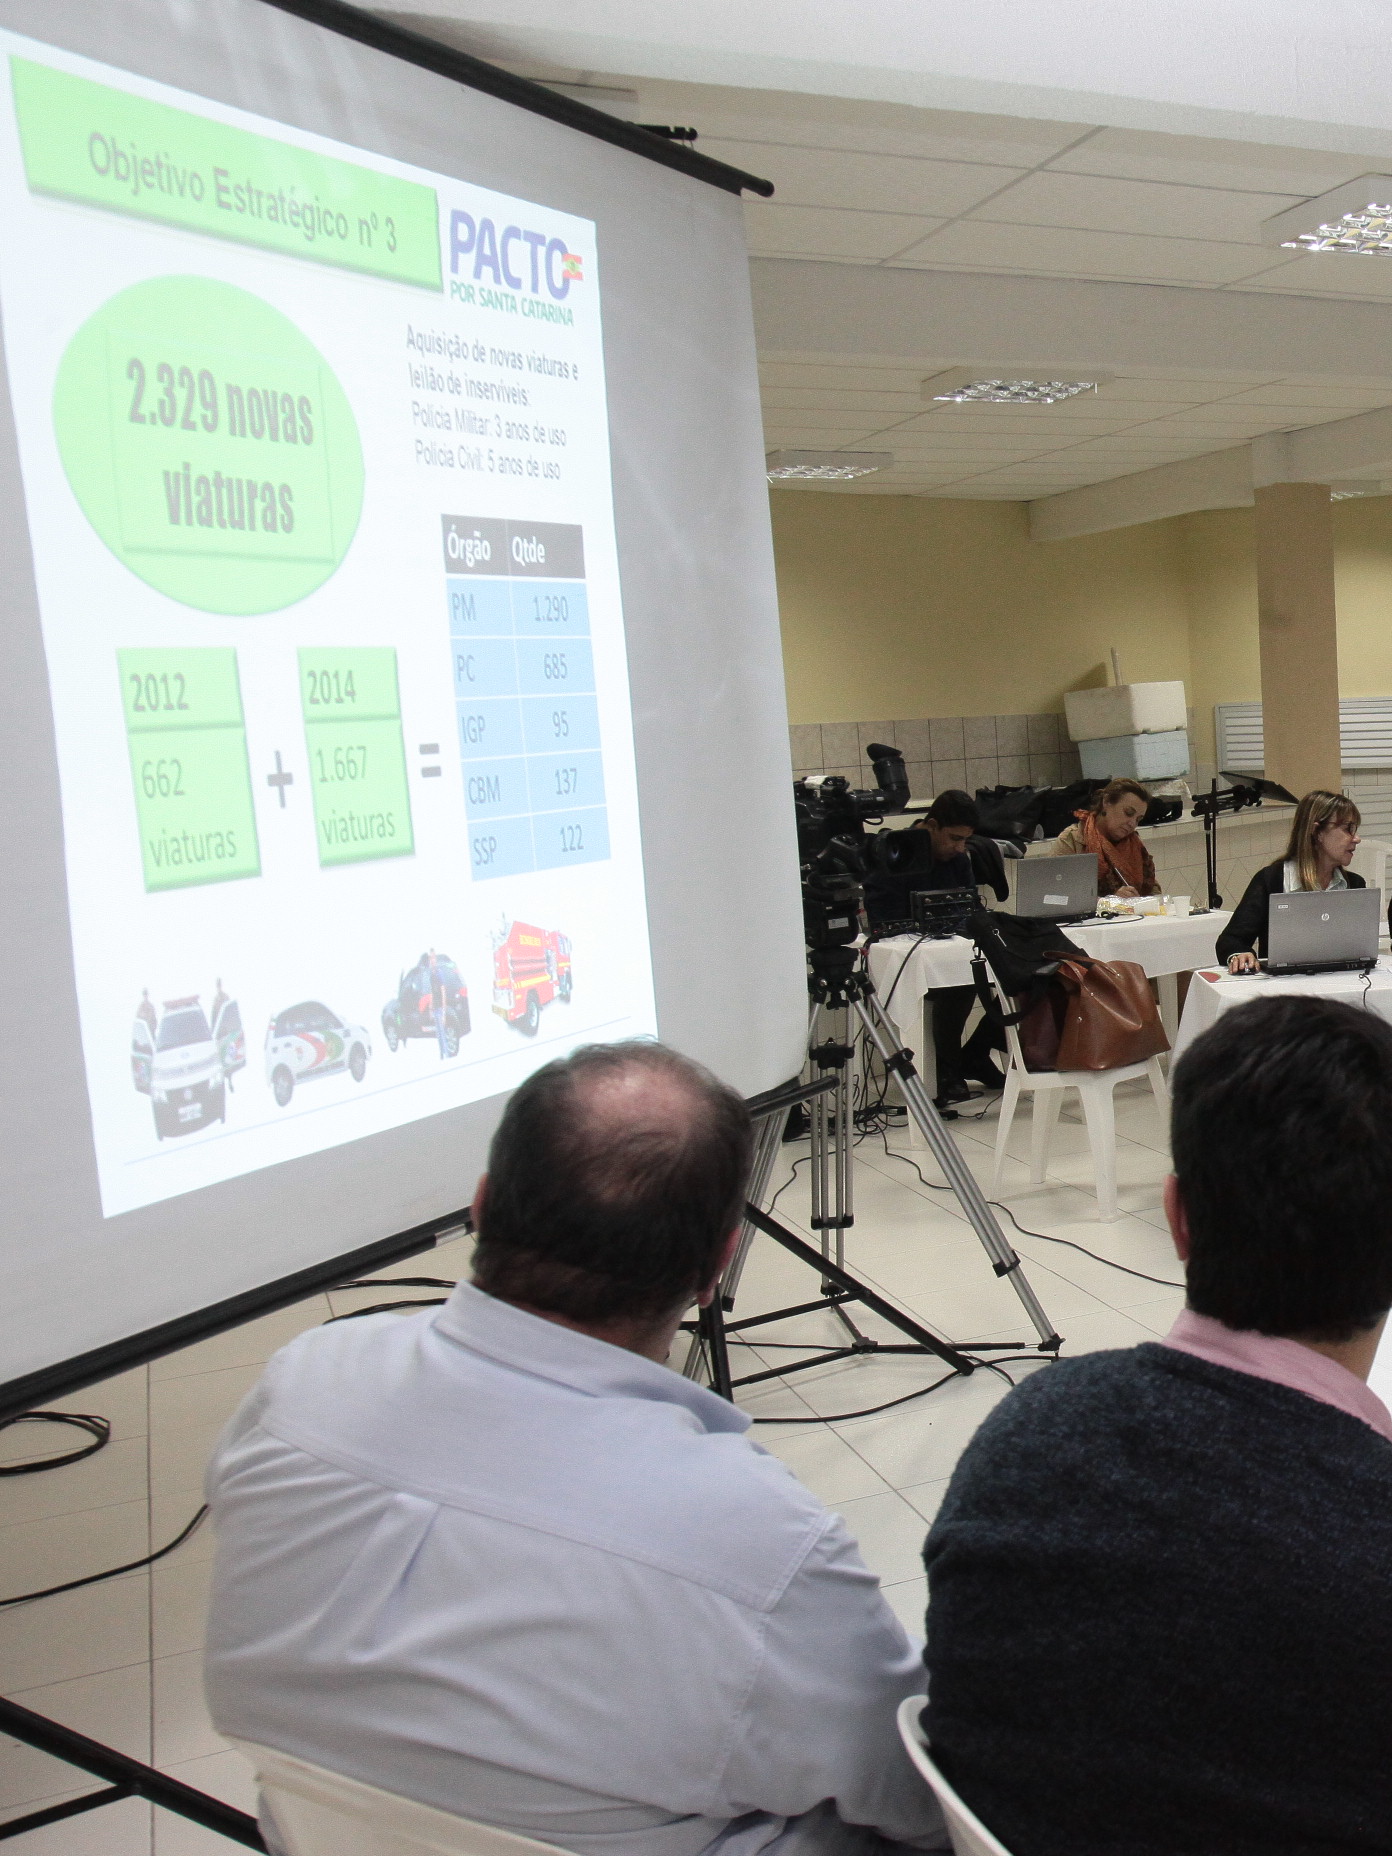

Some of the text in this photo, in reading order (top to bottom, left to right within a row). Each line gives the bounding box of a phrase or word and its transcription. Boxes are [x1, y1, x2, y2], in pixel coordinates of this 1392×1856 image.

[88, 131, 206, 201] Objetivo
[213, 165, 349, 242] Estratégico
[384, 216, 398, 252] 3
[451, 209, 571, 300] PACTO
[451, 280, 574, 327] POR SANTA CATARINA
[406, 323, 579, 381] Aquisição de novas viaturas e
[408, 362, 445, 393] leilão
[446, 371, 462, 397] de
[127, 357, 314, 446] 2.329 novas
[494, 413, 502, 438] 3
[505, 421, 531, 442] anos
[532, 422, 547, 446] de
[548, 427, 567, 447] uso
[487, 448, 495, 473] 5
[498, 455, 524, 476] anos
[526, 456, 540, 478] de
[542, 461, 562, 481] uso
[163, 461, 295, 535] viaturas
[447, 524, 546, 568] Órgão Qtde
[451, 592, 570, 622] PM 1.290
[306, 669, 357, 705] 2014
[456, 653, 569, 682] PC 685
[129, 671, 190, 713] 2012
[461, 710, 570, 744] IGP 95
[141, 757, 186, 799] 662
[316, 744, 368, 783] 1.667
[468, 768, 578, 805] CBM 137
[321, 808, 397, 845] viaturas
[473, 824, 585, 866] SSP 122
[149, 827, 238, 868] viaturas
